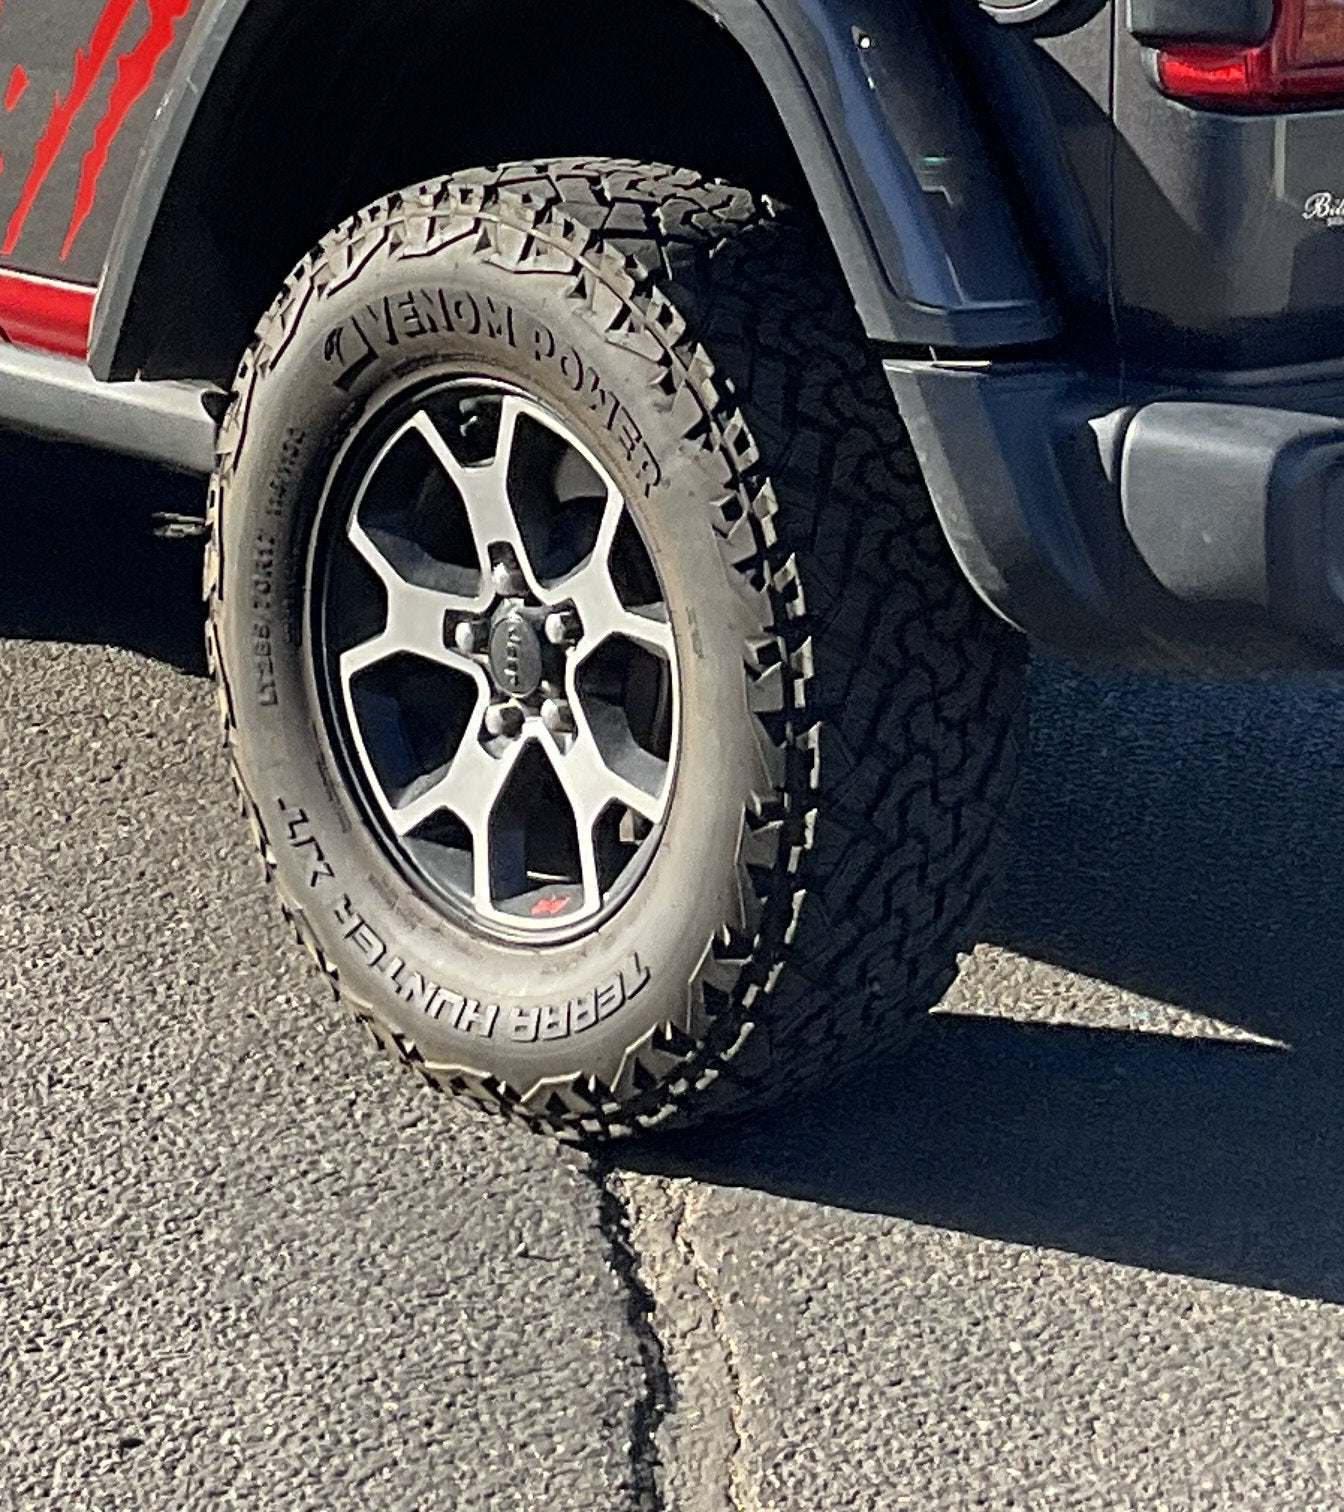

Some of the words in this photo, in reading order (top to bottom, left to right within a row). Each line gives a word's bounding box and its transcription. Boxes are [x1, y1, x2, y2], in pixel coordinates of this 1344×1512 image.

[366, 287, 517, 348] VENOM
[532, 325, 662, 499] POWER
[332, 893, 500, 1041] HUNTER
[508, 951, 652, 1045] TERRA
